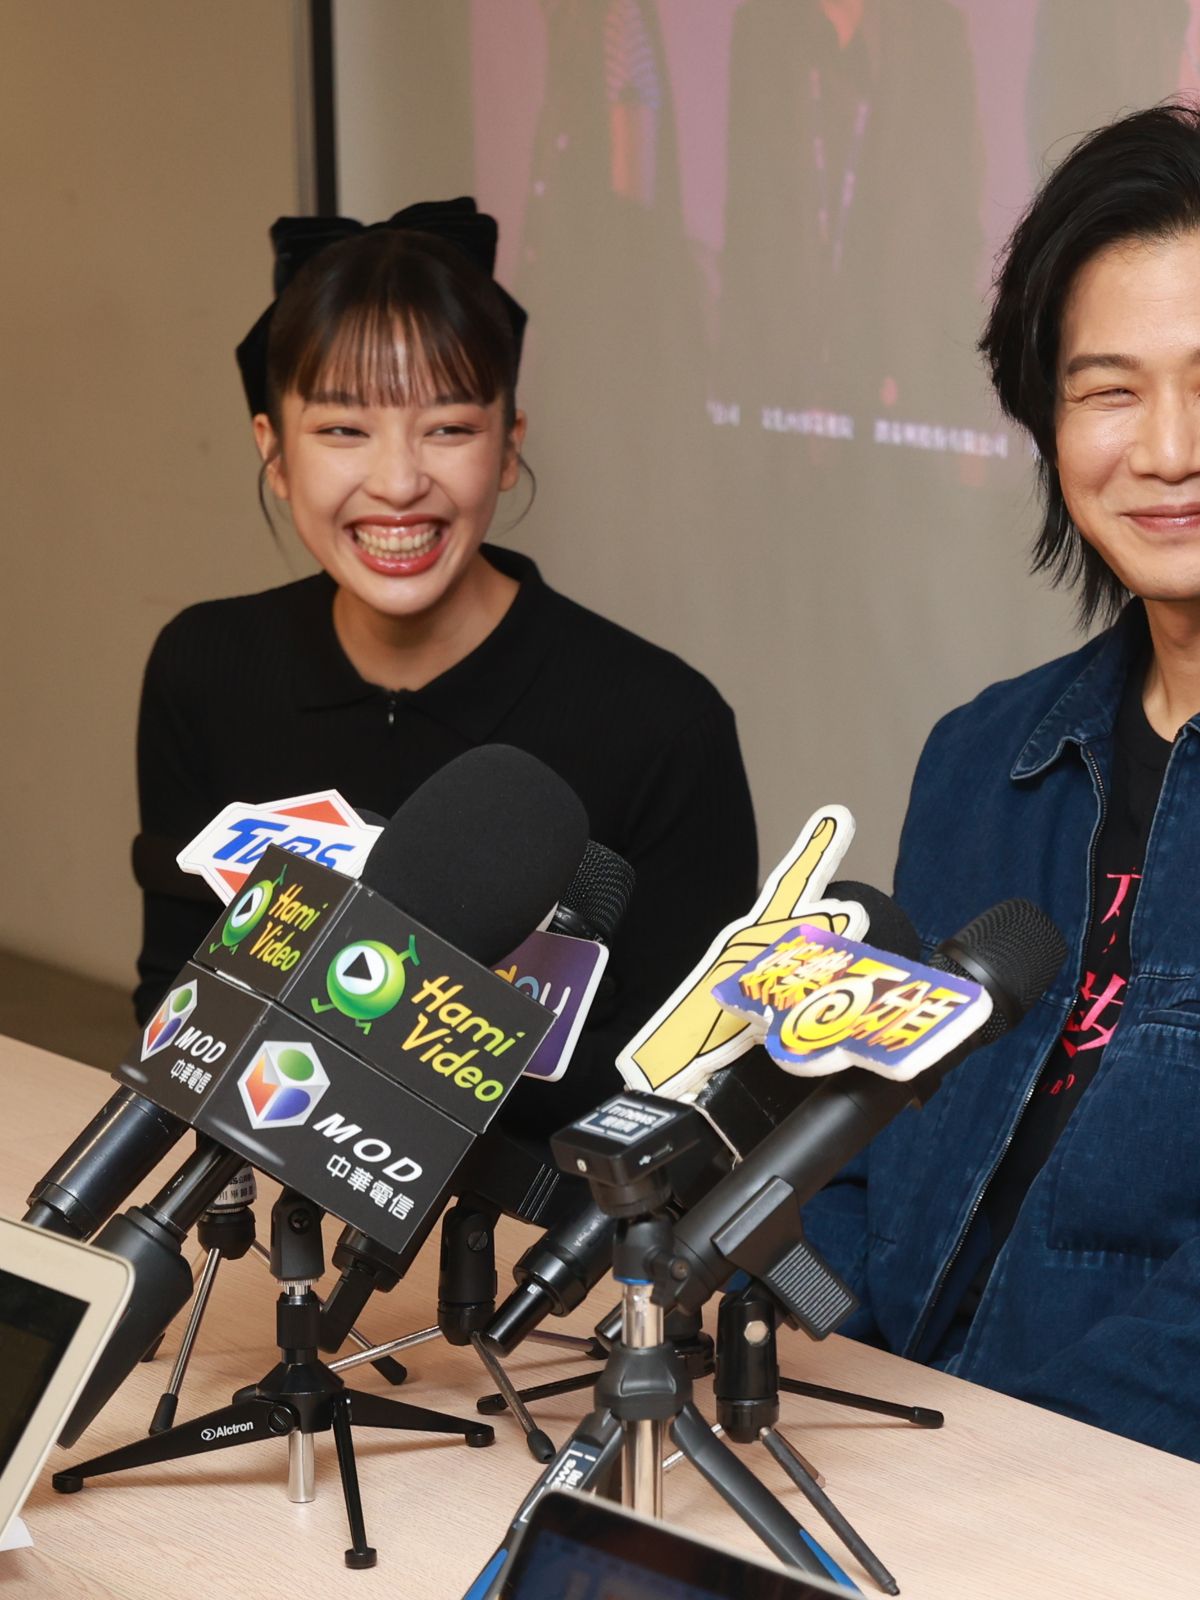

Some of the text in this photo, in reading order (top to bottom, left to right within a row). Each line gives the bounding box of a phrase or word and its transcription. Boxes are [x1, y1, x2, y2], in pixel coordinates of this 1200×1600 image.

[268, 883, 329, 932] Hami
[250, 921, 301, 972] Video
[411, 975, 526, 1057] Hami
[174, 1026, 227, 1064] MOD
[401, 1013, 504, 1102] Video
[170, 1059, 213, 1094] 中華電信
[312, 1112, 423, 1183] MOD
[326, 1154, 415, 1221] 中華電信
[216, 1421, 254, 1438] Alctron
